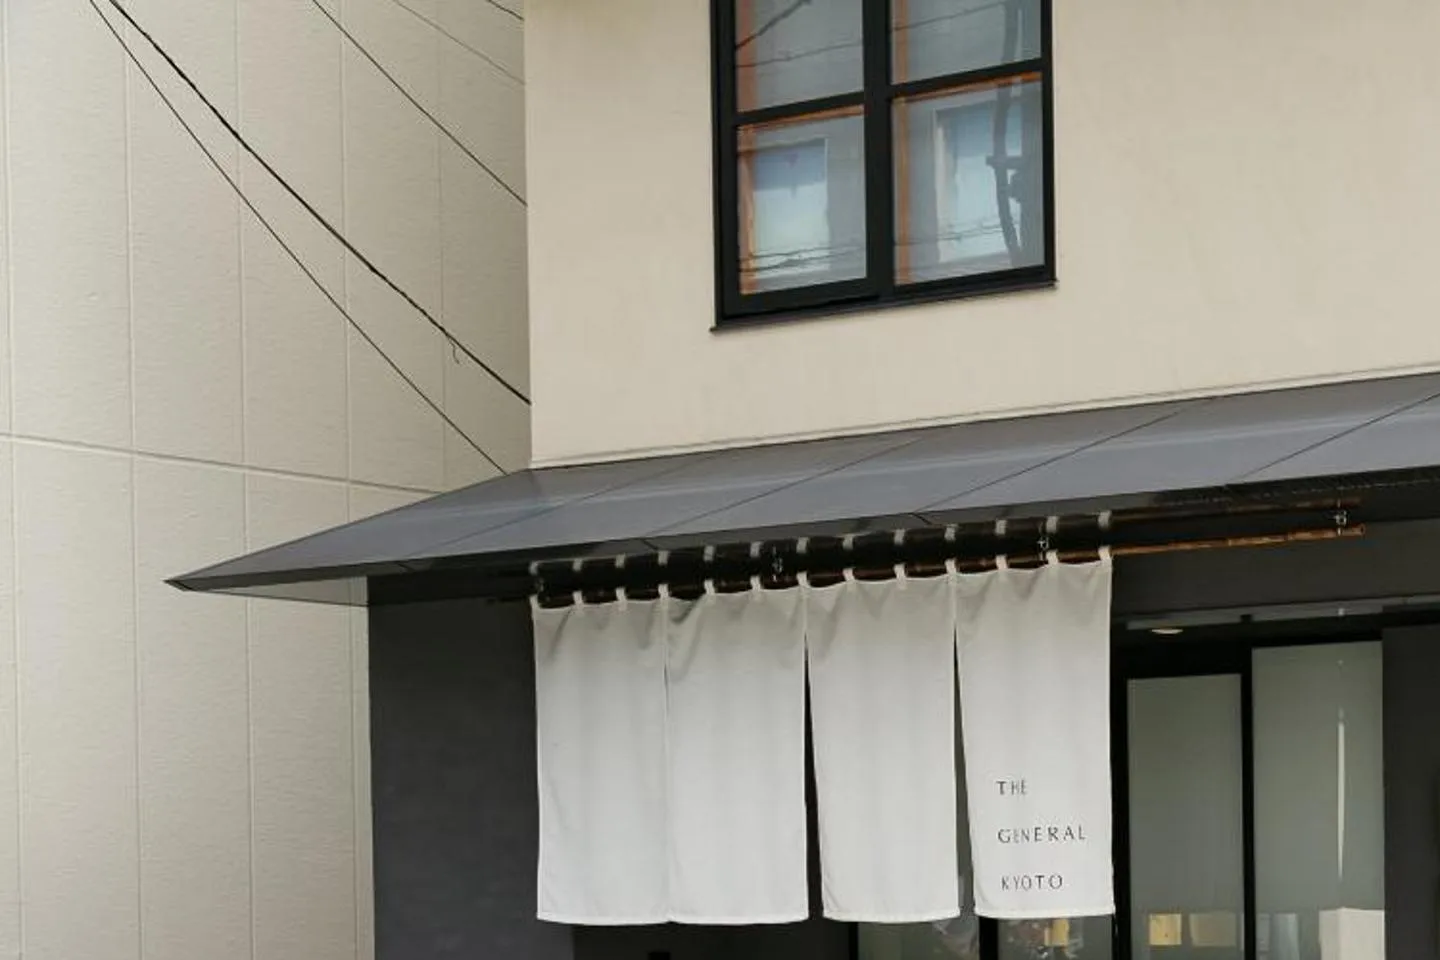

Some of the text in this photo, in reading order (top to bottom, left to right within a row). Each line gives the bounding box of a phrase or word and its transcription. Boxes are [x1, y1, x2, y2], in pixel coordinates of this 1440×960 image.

[996, 780, 1028, 795] THE
[997, 825, 1086, 844] GENERAL
[1001, 874, 1063, 891] KYOTO
